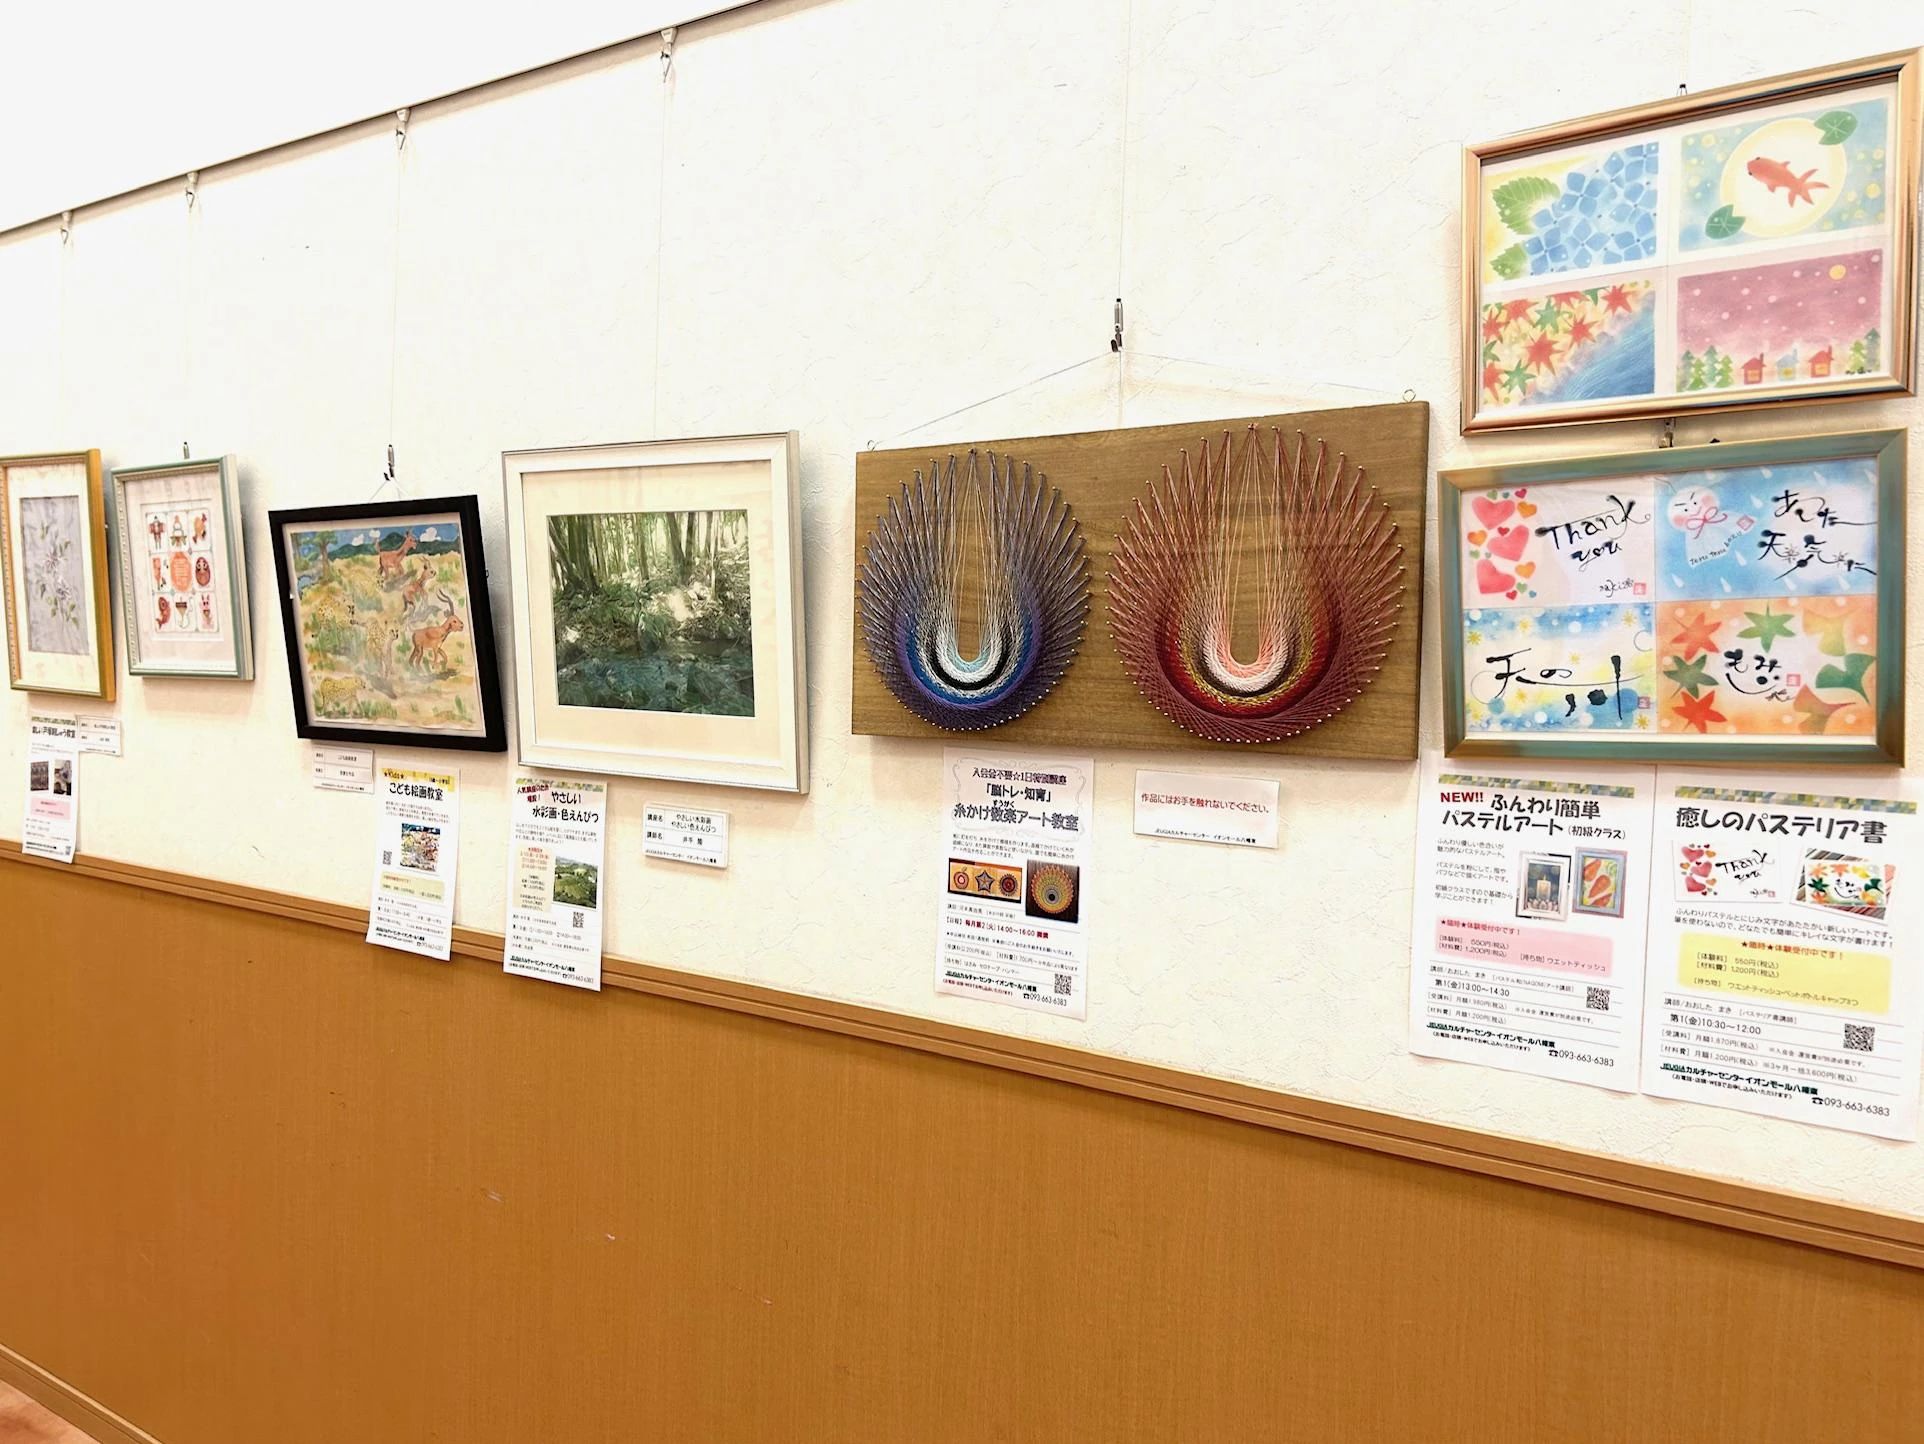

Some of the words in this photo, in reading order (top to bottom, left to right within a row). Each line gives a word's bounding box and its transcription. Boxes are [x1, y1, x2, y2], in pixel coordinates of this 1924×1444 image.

[1535, 495, 1650, 550] Thank
[1571, 540, 1622, 571] you
[389, 782, 444, 801] こども絵画教室
[551, 791, 582, 804] やさしい
[1141, 793, 1270, 813] 作品にはお手を触れないでください。
[532, 805, 599, 823] 水彩画・色えんぴつ
[953, 803, 1079, 832] 糸かけ数楽アート教室
[1491, 794, 1601, 819] ふんわり簡単
[1442, 810, 1563, 835] パステルアート
[1676, 807, 1887, 844] 癒しのパステリア書
[1559, 1049, 1614, 1067] 093-663-6383
[1825, 1096, 1890, 1117] 093-663-6383
